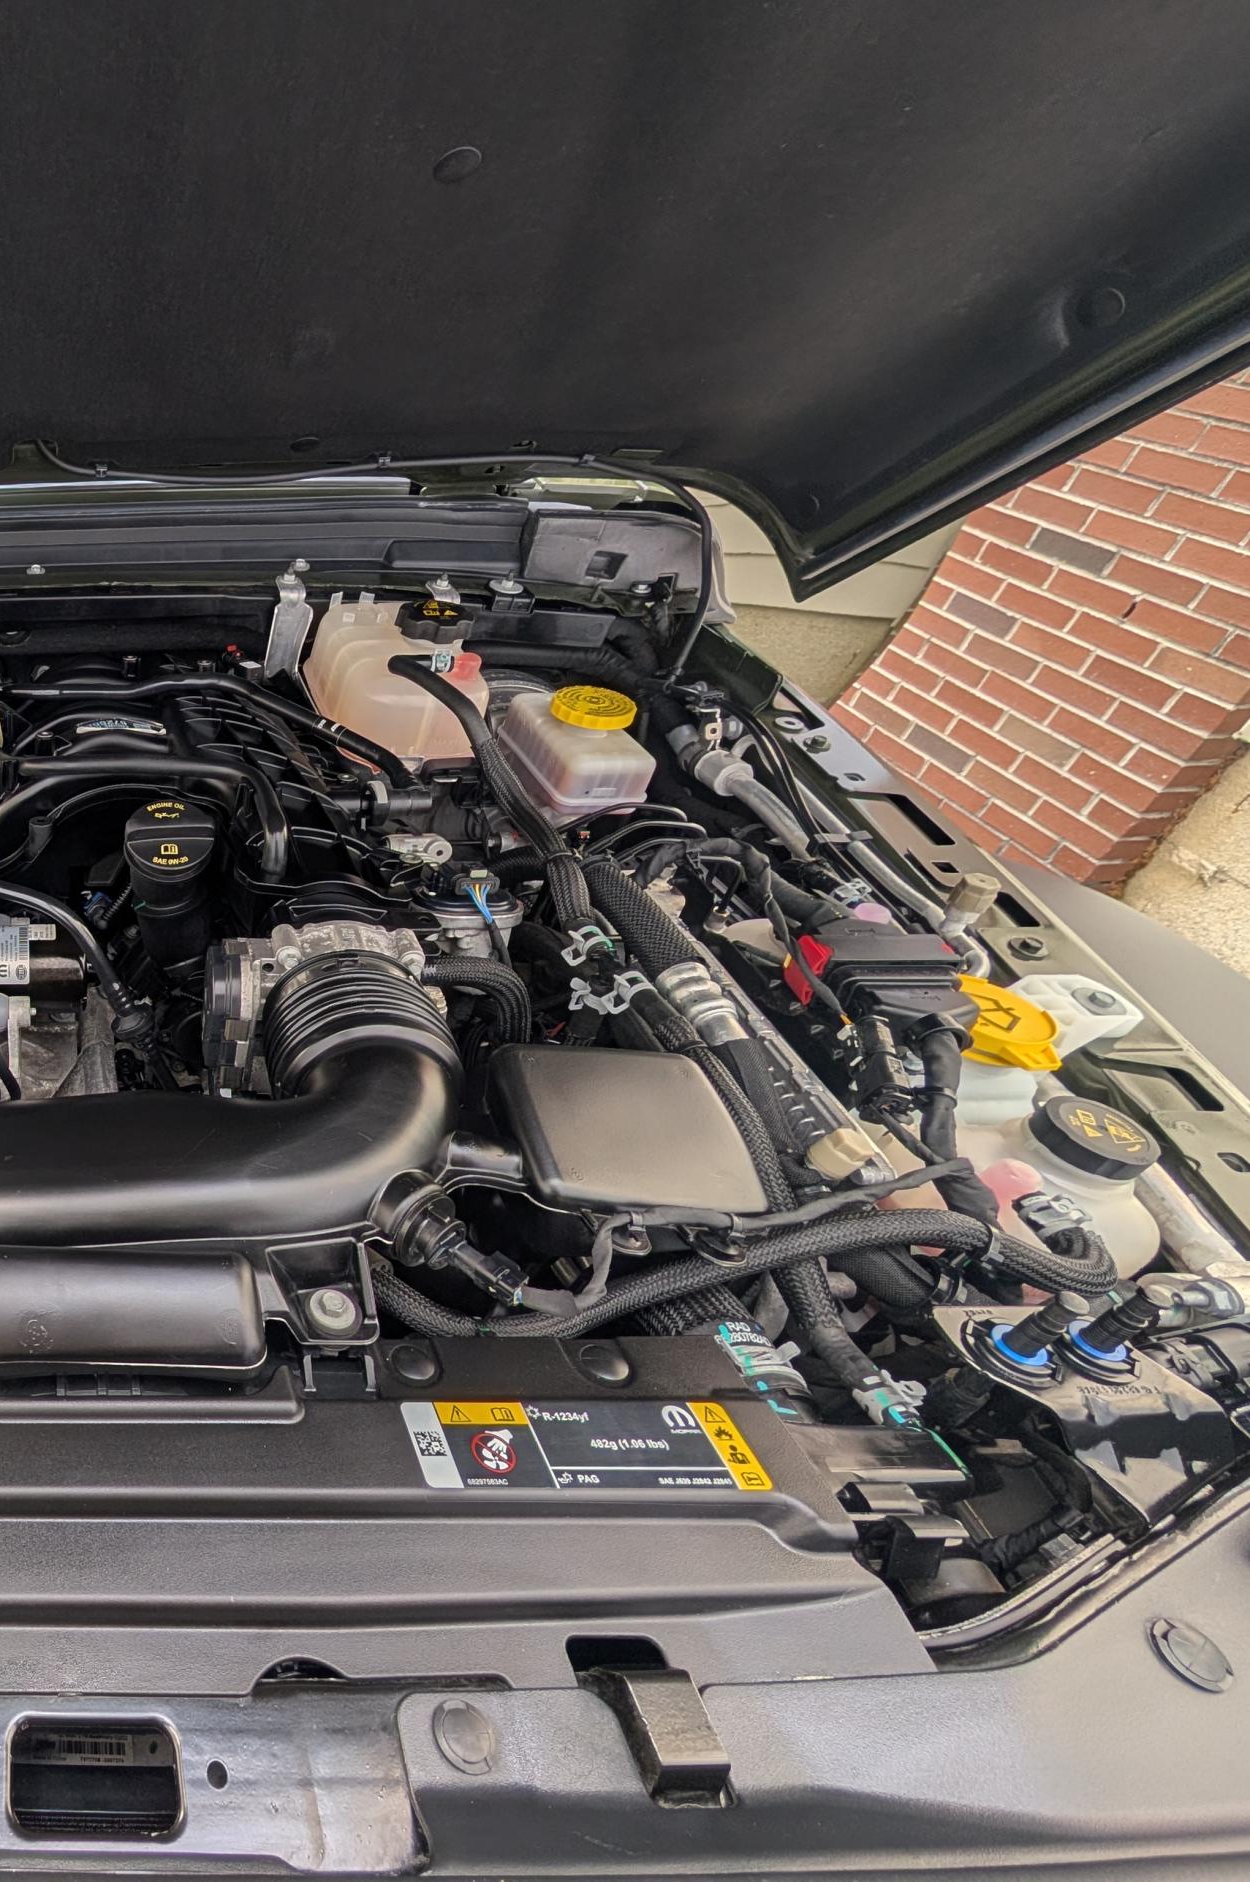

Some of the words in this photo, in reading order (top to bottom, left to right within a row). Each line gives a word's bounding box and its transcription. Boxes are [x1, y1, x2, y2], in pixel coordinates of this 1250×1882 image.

[147, 802, 173, 811] ENGINE
[152, 856, 167, 864] SAE
[725, 1321, 751, 1332] RAD
[541, 1411, 589, 1423] R-1234yf
[590, 1439, 618, 1450] 482g
[646, 1439, 670, 1451] lbs)
[577, 1474, 600, 1484] PAG
